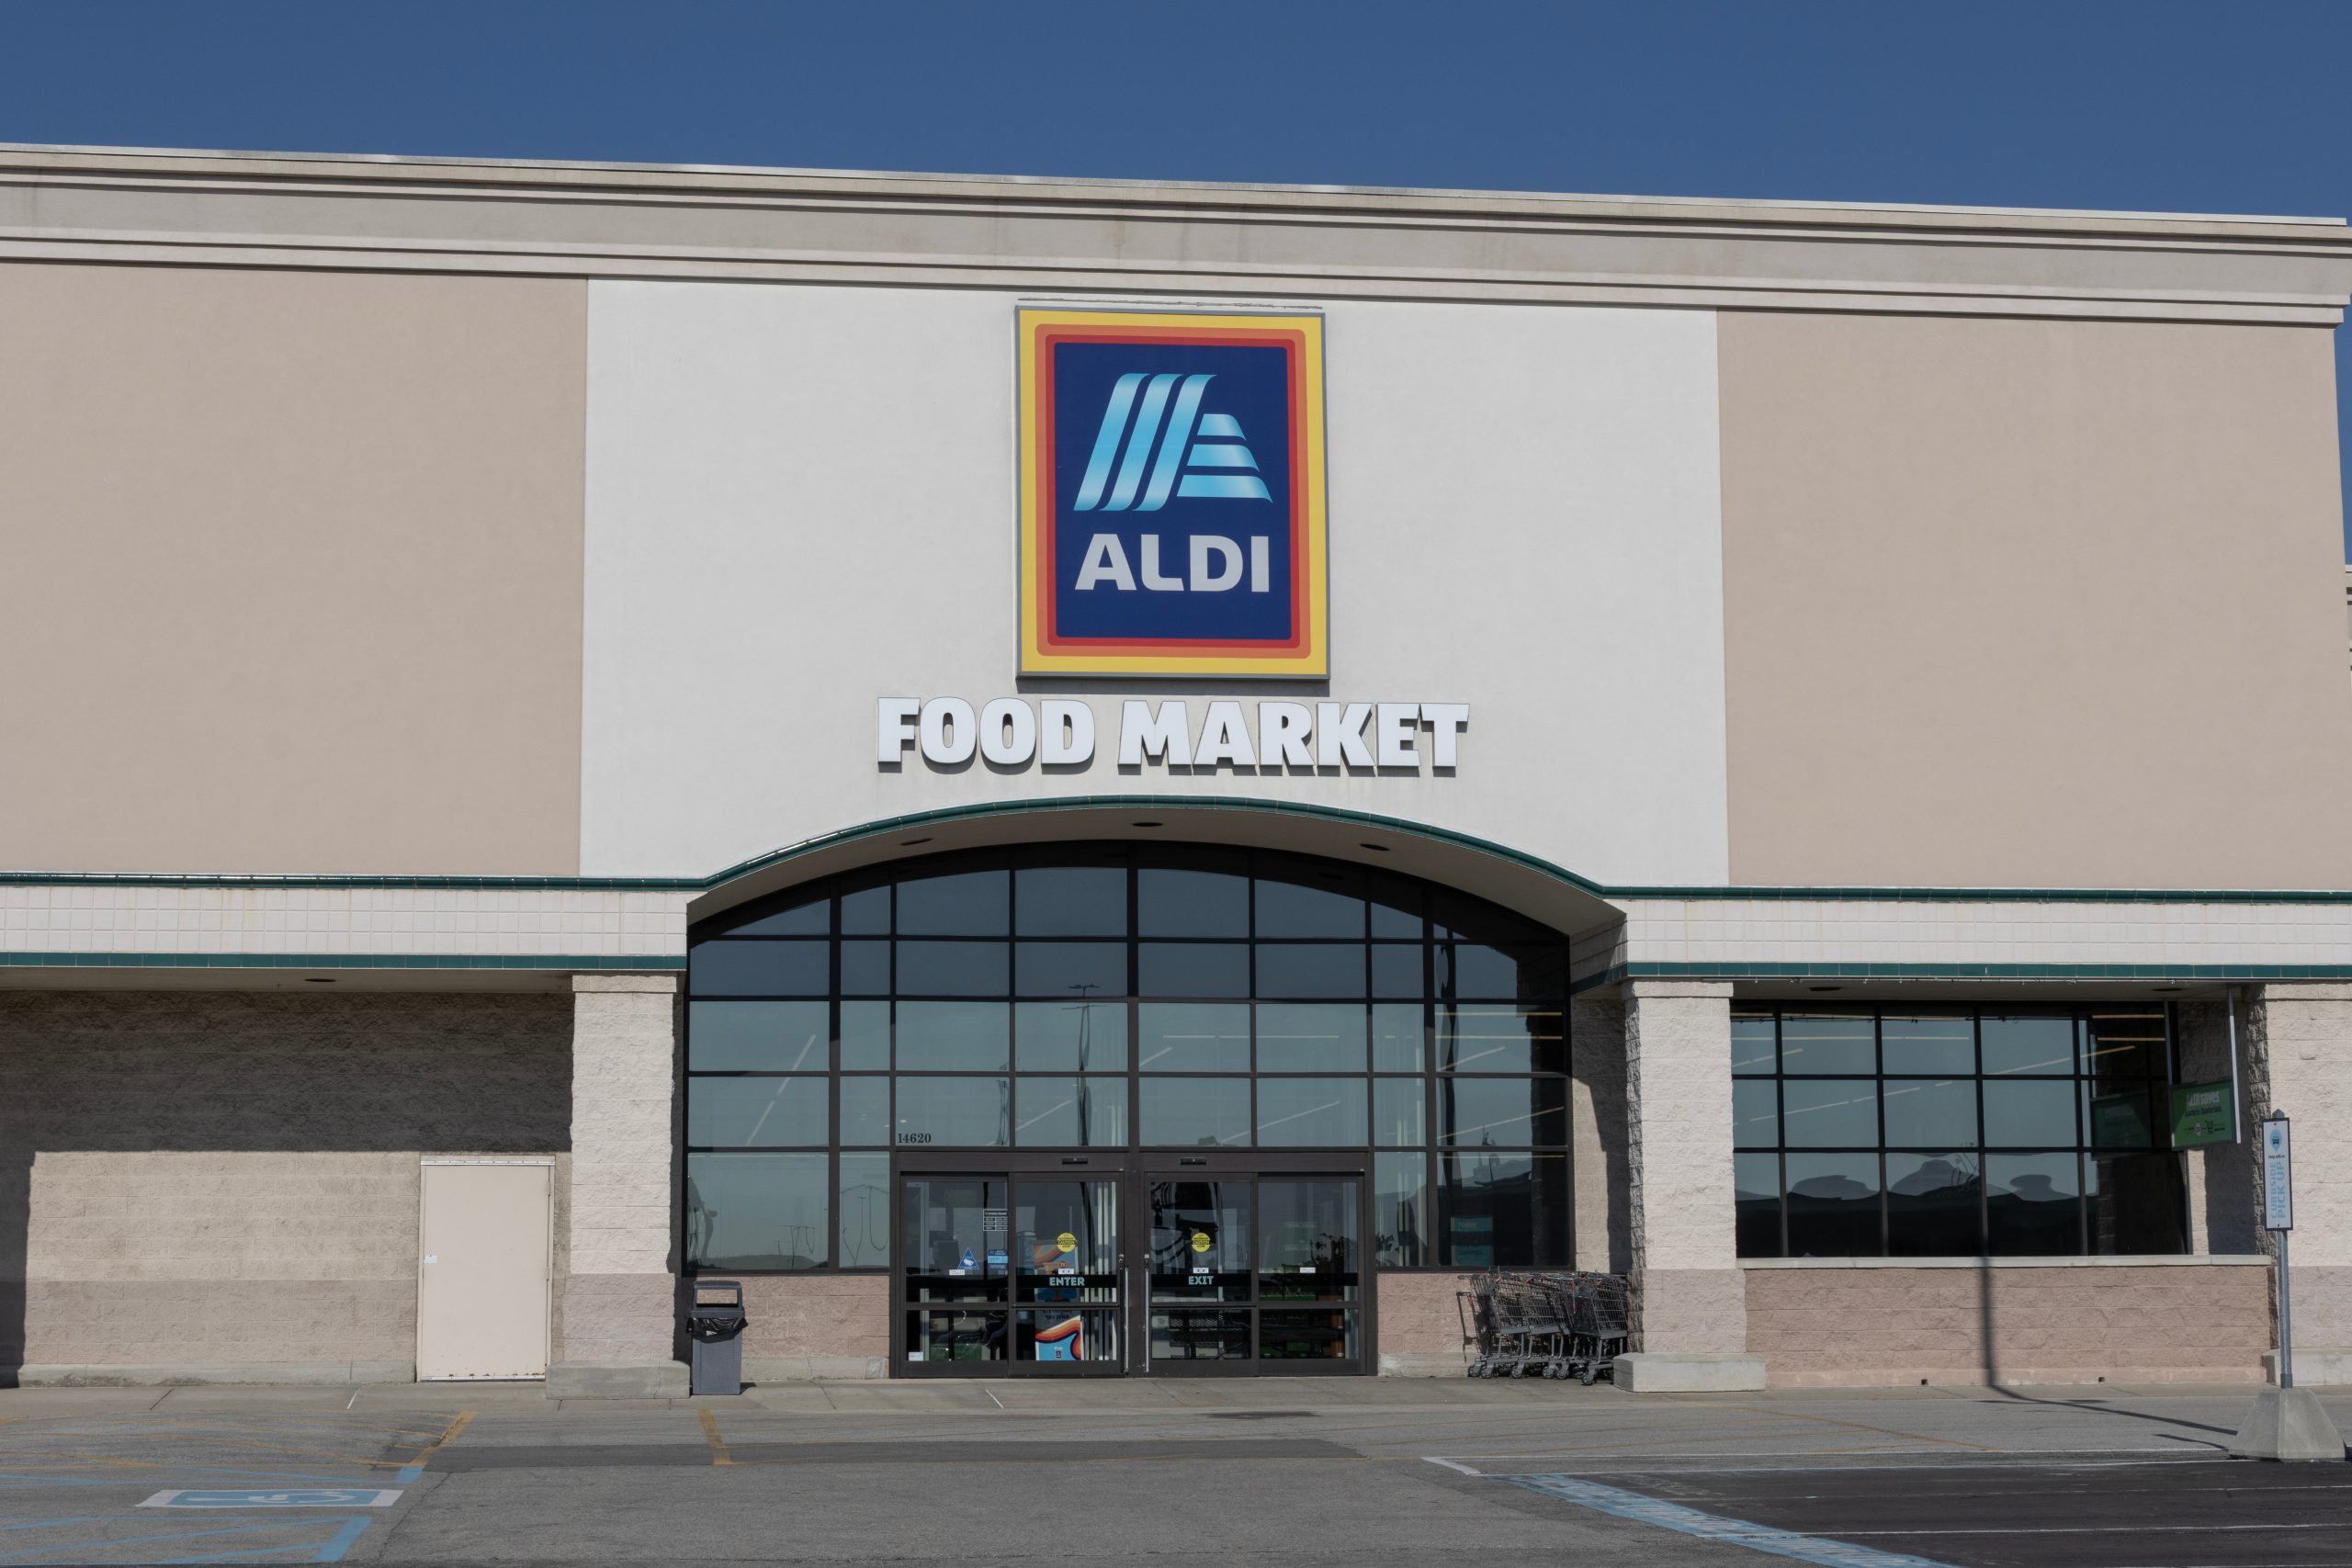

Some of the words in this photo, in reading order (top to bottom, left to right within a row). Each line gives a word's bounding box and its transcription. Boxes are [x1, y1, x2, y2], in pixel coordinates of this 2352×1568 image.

[1074, 533, 1270, 592] ALDI
[877, 696, 1096, 770] FOOD
[1117, 700, 1470, 774] MARKET
[897, 1133, 932, 1144] 14620
[2277, 1161, 2286, 1181] UP
[2269, 1161, 2278, 1219] CURBSIDE
[2278, 1185, 2286, 1219] PICK
[1049, 1277, 1085, 1286] ENTER
[1188, 1275, 1214, 1285] EXIT
